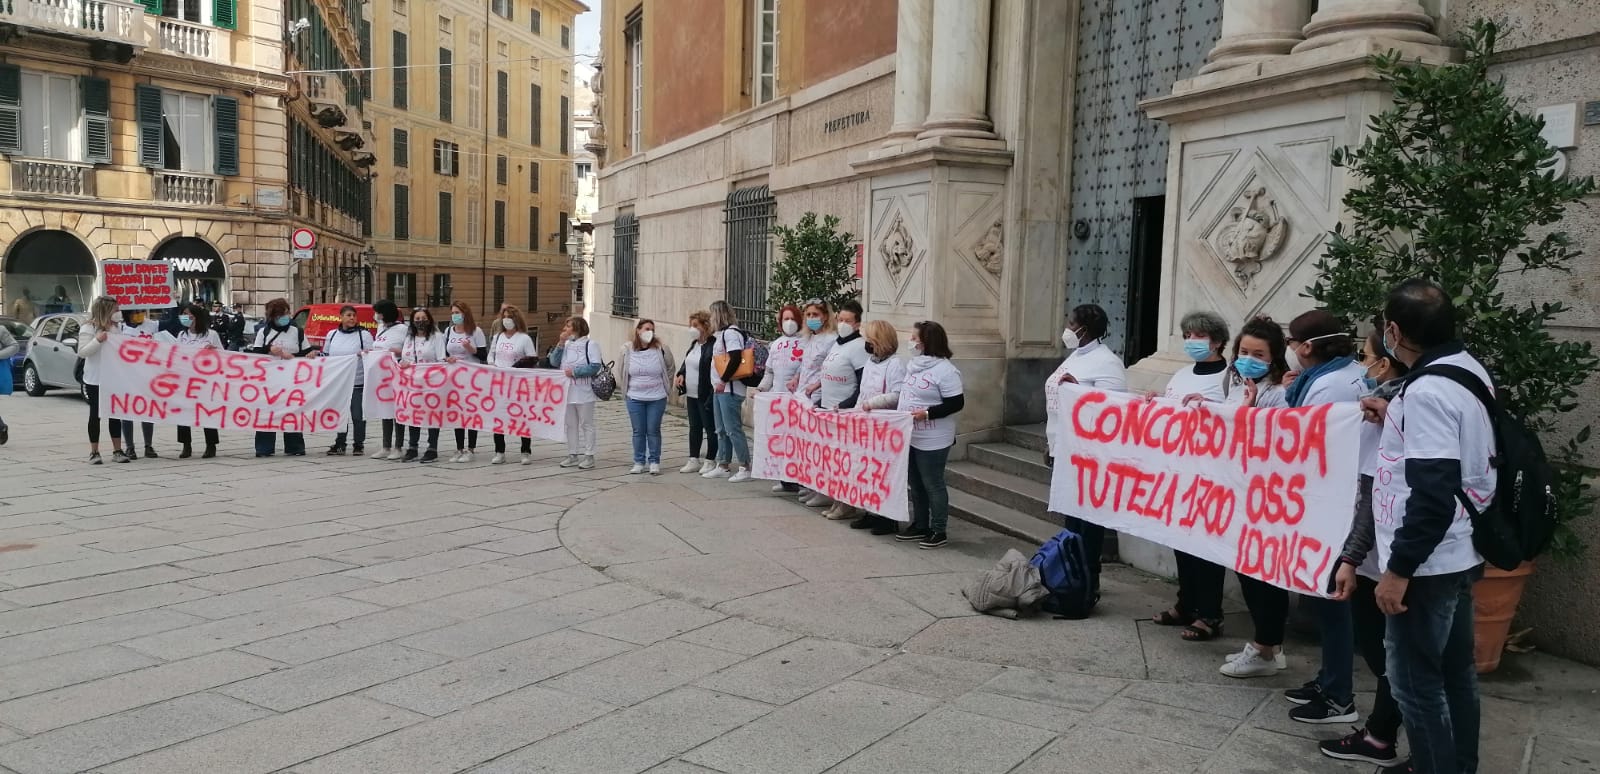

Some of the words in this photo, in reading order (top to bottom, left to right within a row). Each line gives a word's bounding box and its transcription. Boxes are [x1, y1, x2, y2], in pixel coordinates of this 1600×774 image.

[824, 110, 870, 133] PREFETTURA
[777, 340, 799, 350] OSS
[150, 373, 307, 407] GENOVA
[379, 354, 565, 405] SBLOCCHIAMO
[195, 402, 341, 432] MOLLANO
[395, 408, 484, 429] GENOVA
[492, 417, 532, 438] 274
[769, 396, 905, 454] SBLOCCHIAMO
[1072, 387, 1227, 459] CONCORSO
[767, 434, 852, 477] CONCORSO
[785, 462, 812, 485] OSS
[815, 471, 882, 512] GENOVA
[1071, 454, 1179, 527] TUTELA
[1179, 474, 1236, 537] 1700
[1246, 472, 1306, 526] OSS
